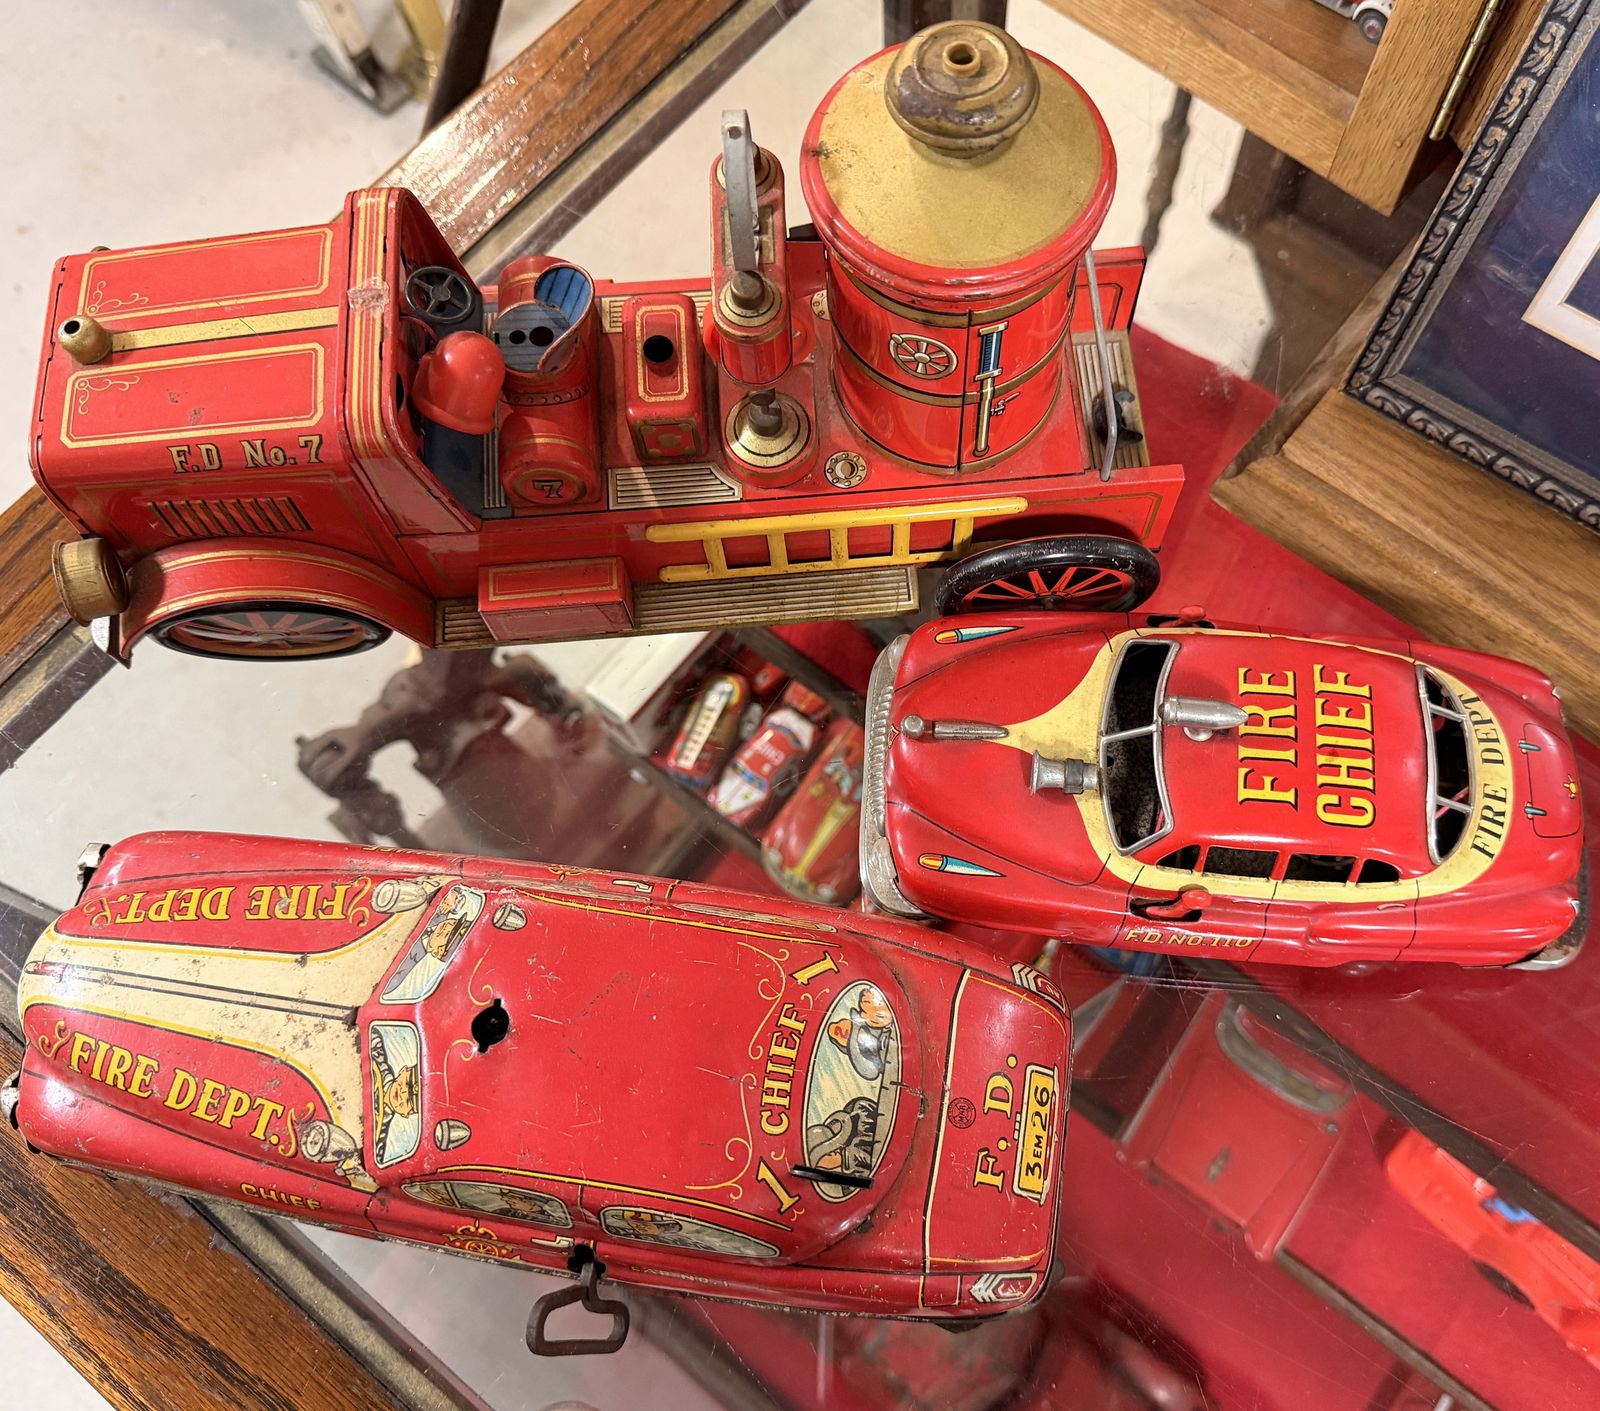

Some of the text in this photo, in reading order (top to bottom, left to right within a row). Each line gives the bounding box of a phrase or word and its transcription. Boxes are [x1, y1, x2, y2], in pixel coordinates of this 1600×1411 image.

[532, 479, 564, 499] 7
[1238, 667, 1298, 812] FIRE
[1313, 664, 1377, 829] CHIEF
[1458, 693, 1508, 862] FIRE DEPT
[114, 884, 352, 925] FIRE DEPT.
[67, 1031, 286, 1146] FIRE DEPT.
[757, 950, 841, 1215] 1 CHIEF 1
[239, 1182, 321, 1211] CHIEF
